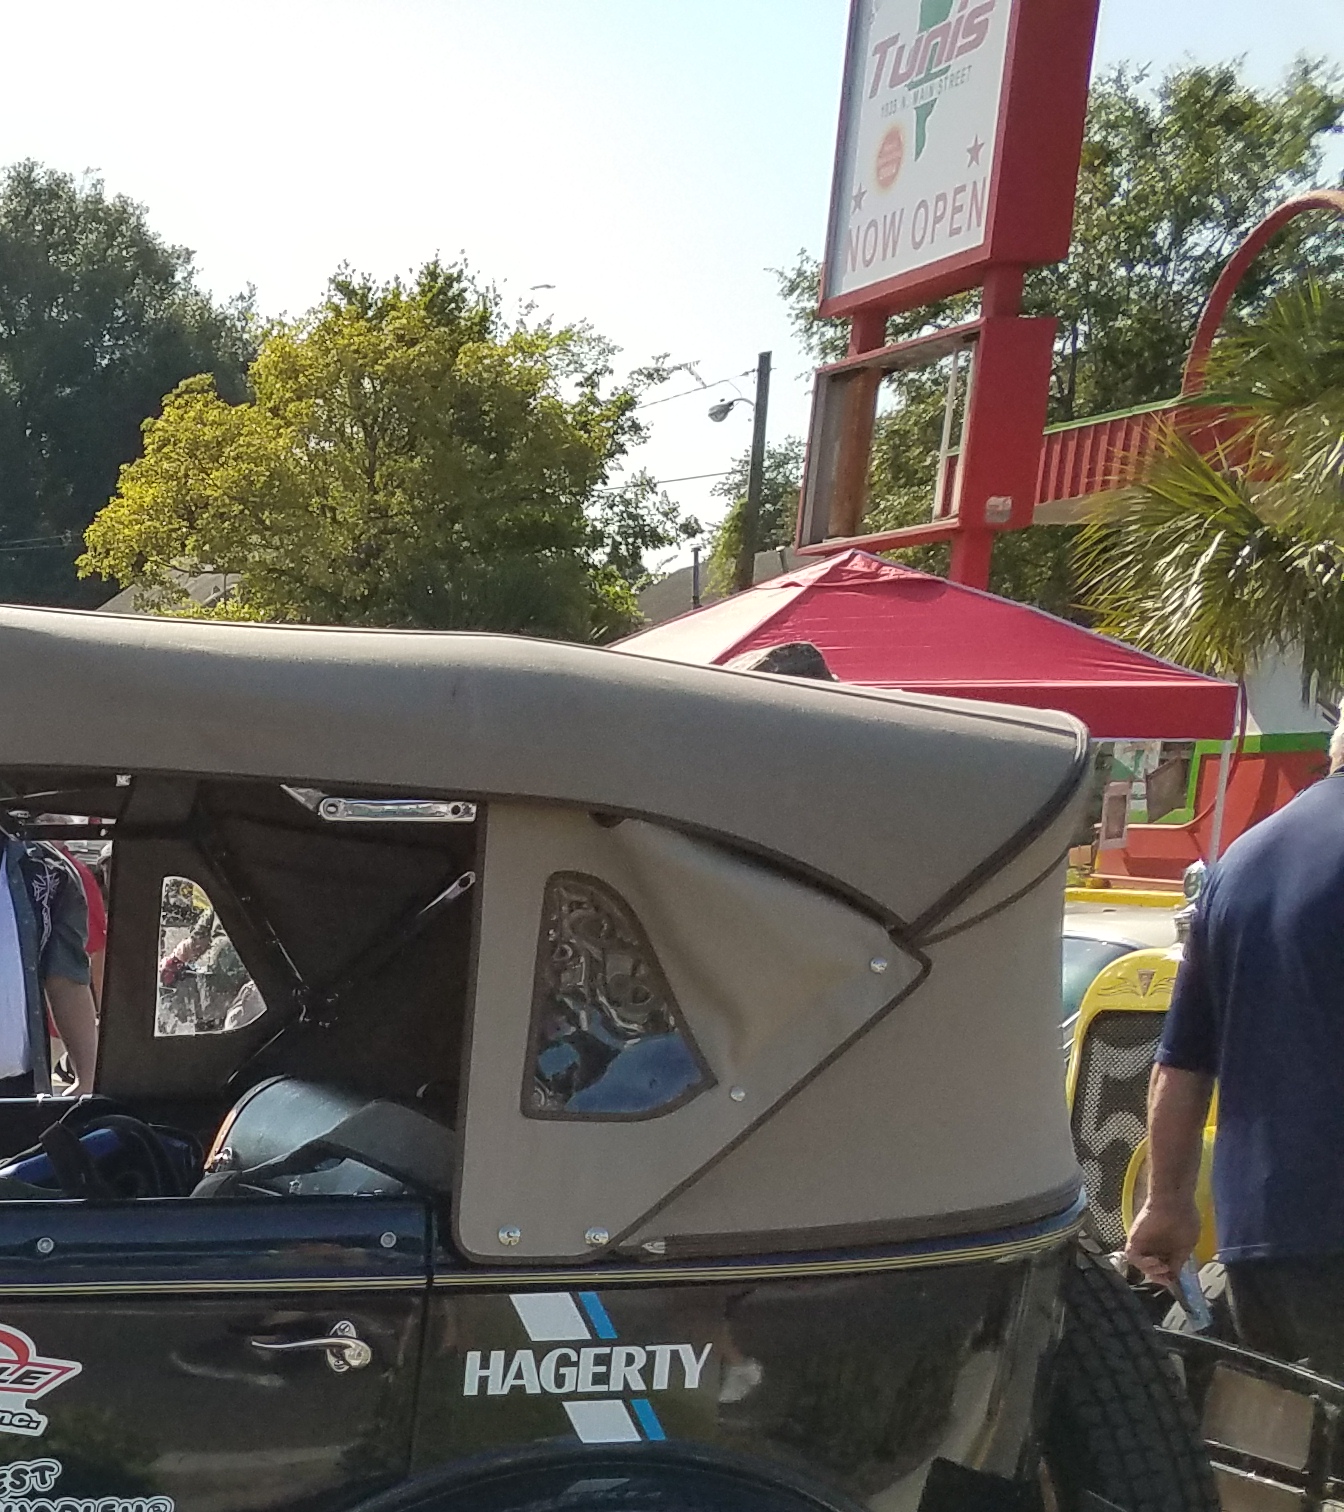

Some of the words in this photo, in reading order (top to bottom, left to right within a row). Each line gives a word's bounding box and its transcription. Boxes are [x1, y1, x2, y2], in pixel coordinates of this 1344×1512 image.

[848, 208, 905, 272] NOW
[911, 176, 988, 251] OPEN
[463, 1342, 713, 1397] HAGERTY
